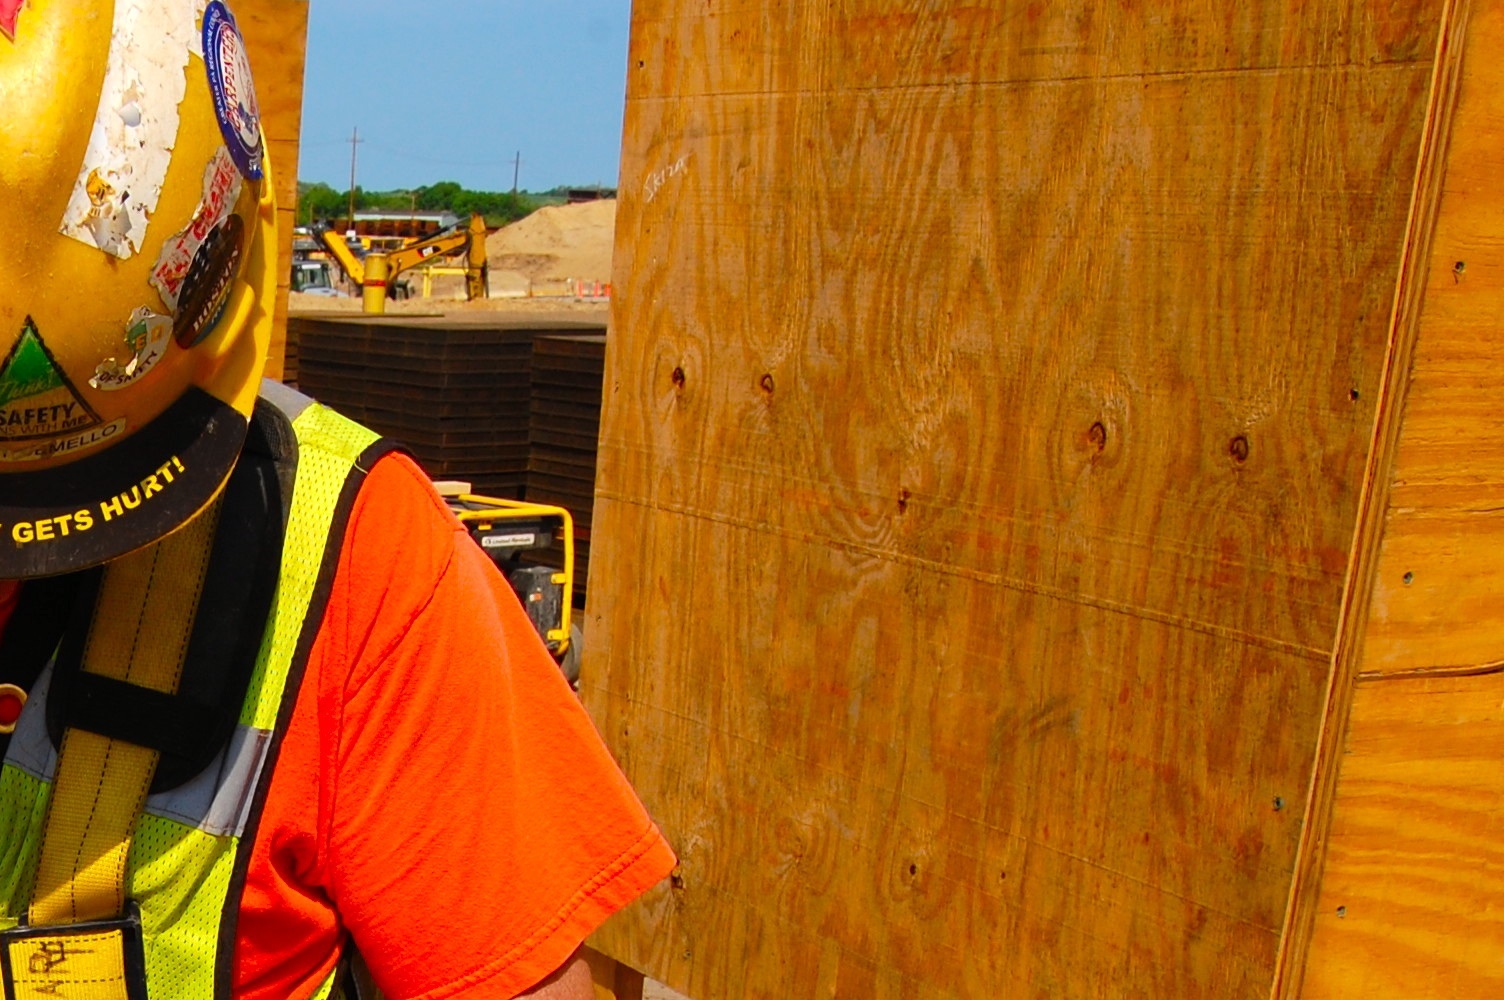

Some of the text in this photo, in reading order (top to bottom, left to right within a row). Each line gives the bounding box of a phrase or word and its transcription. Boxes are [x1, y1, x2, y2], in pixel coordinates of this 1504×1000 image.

[21, 420, 58, 434] WITH
[61, 414, 88, 428] ME
[12, 509, 94, 544] GETS
[100, 456, 186, 521] HURT!
